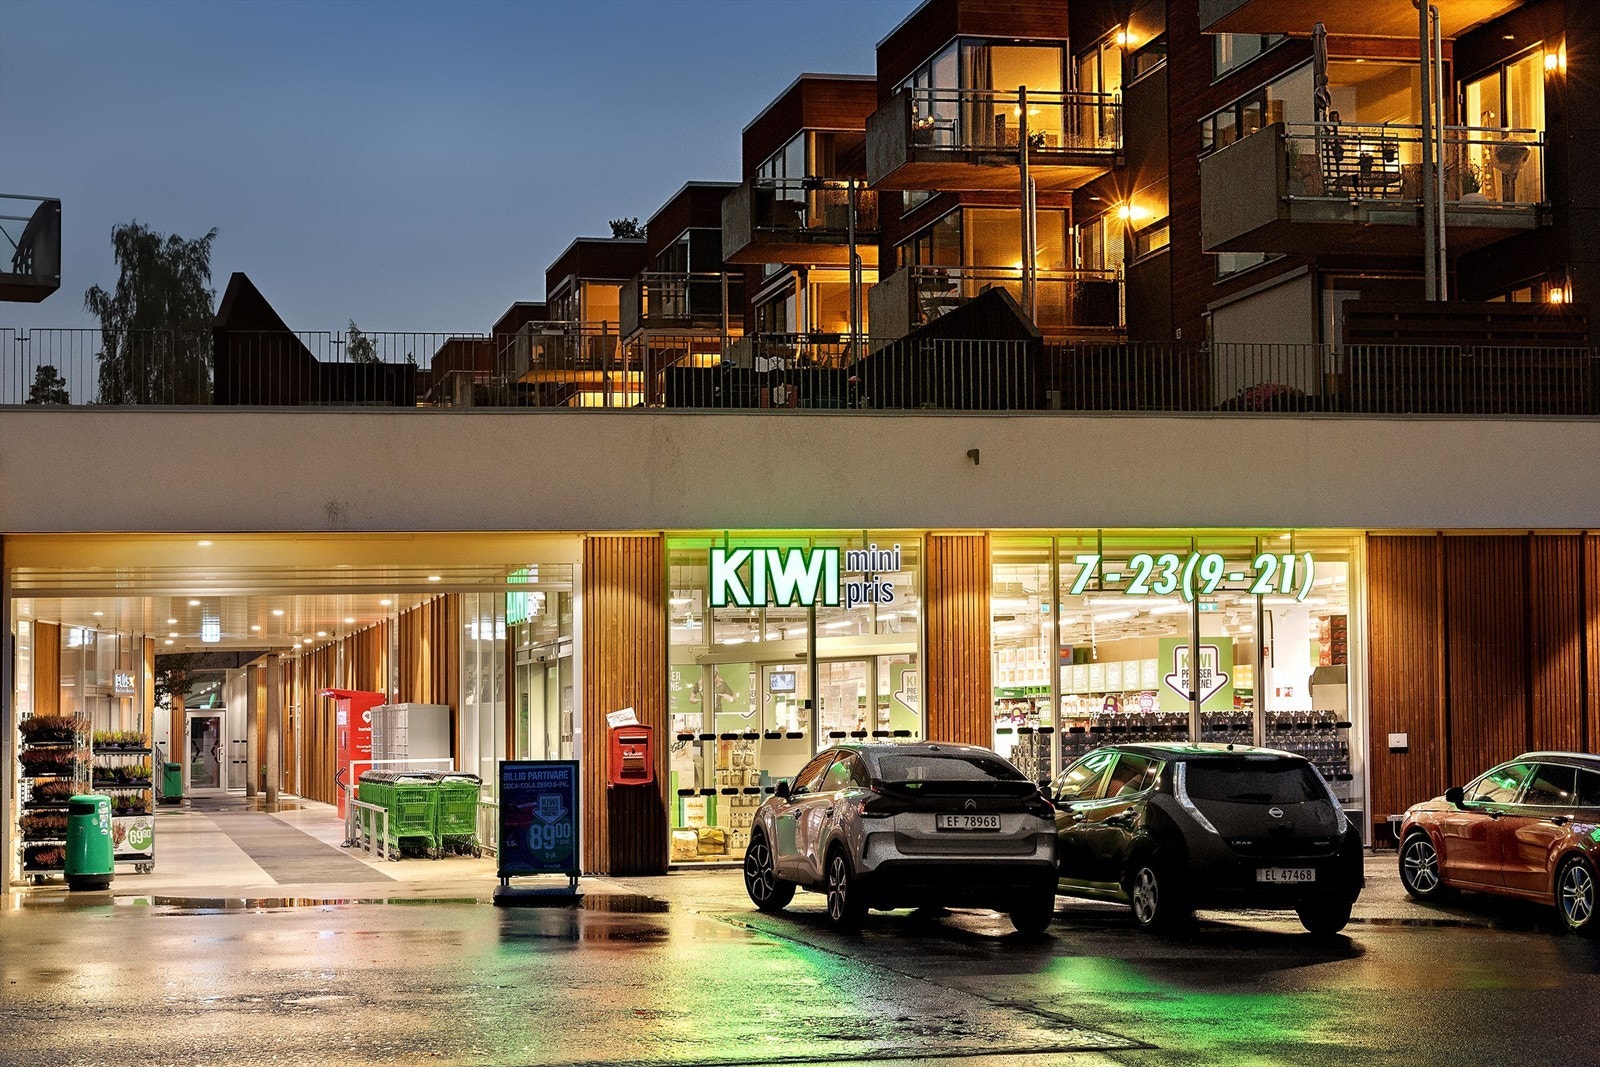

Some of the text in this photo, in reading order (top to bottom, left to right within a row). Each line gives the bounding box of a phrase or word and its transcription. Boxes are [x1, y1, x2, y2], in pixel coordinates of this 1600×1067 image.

[710, 544, 900, 607] KIWI mini
[846, 576, 895, 609] pris
[503, 770, 569, 781] BILLIG PARTIVARE
[503, 782, 536, 790] COCA-COLA
[536, 781, 553, 789] ZERO
[947, 816, 997, 827] EF 78968
[1265, 869, 1312, 881] EL 47468
